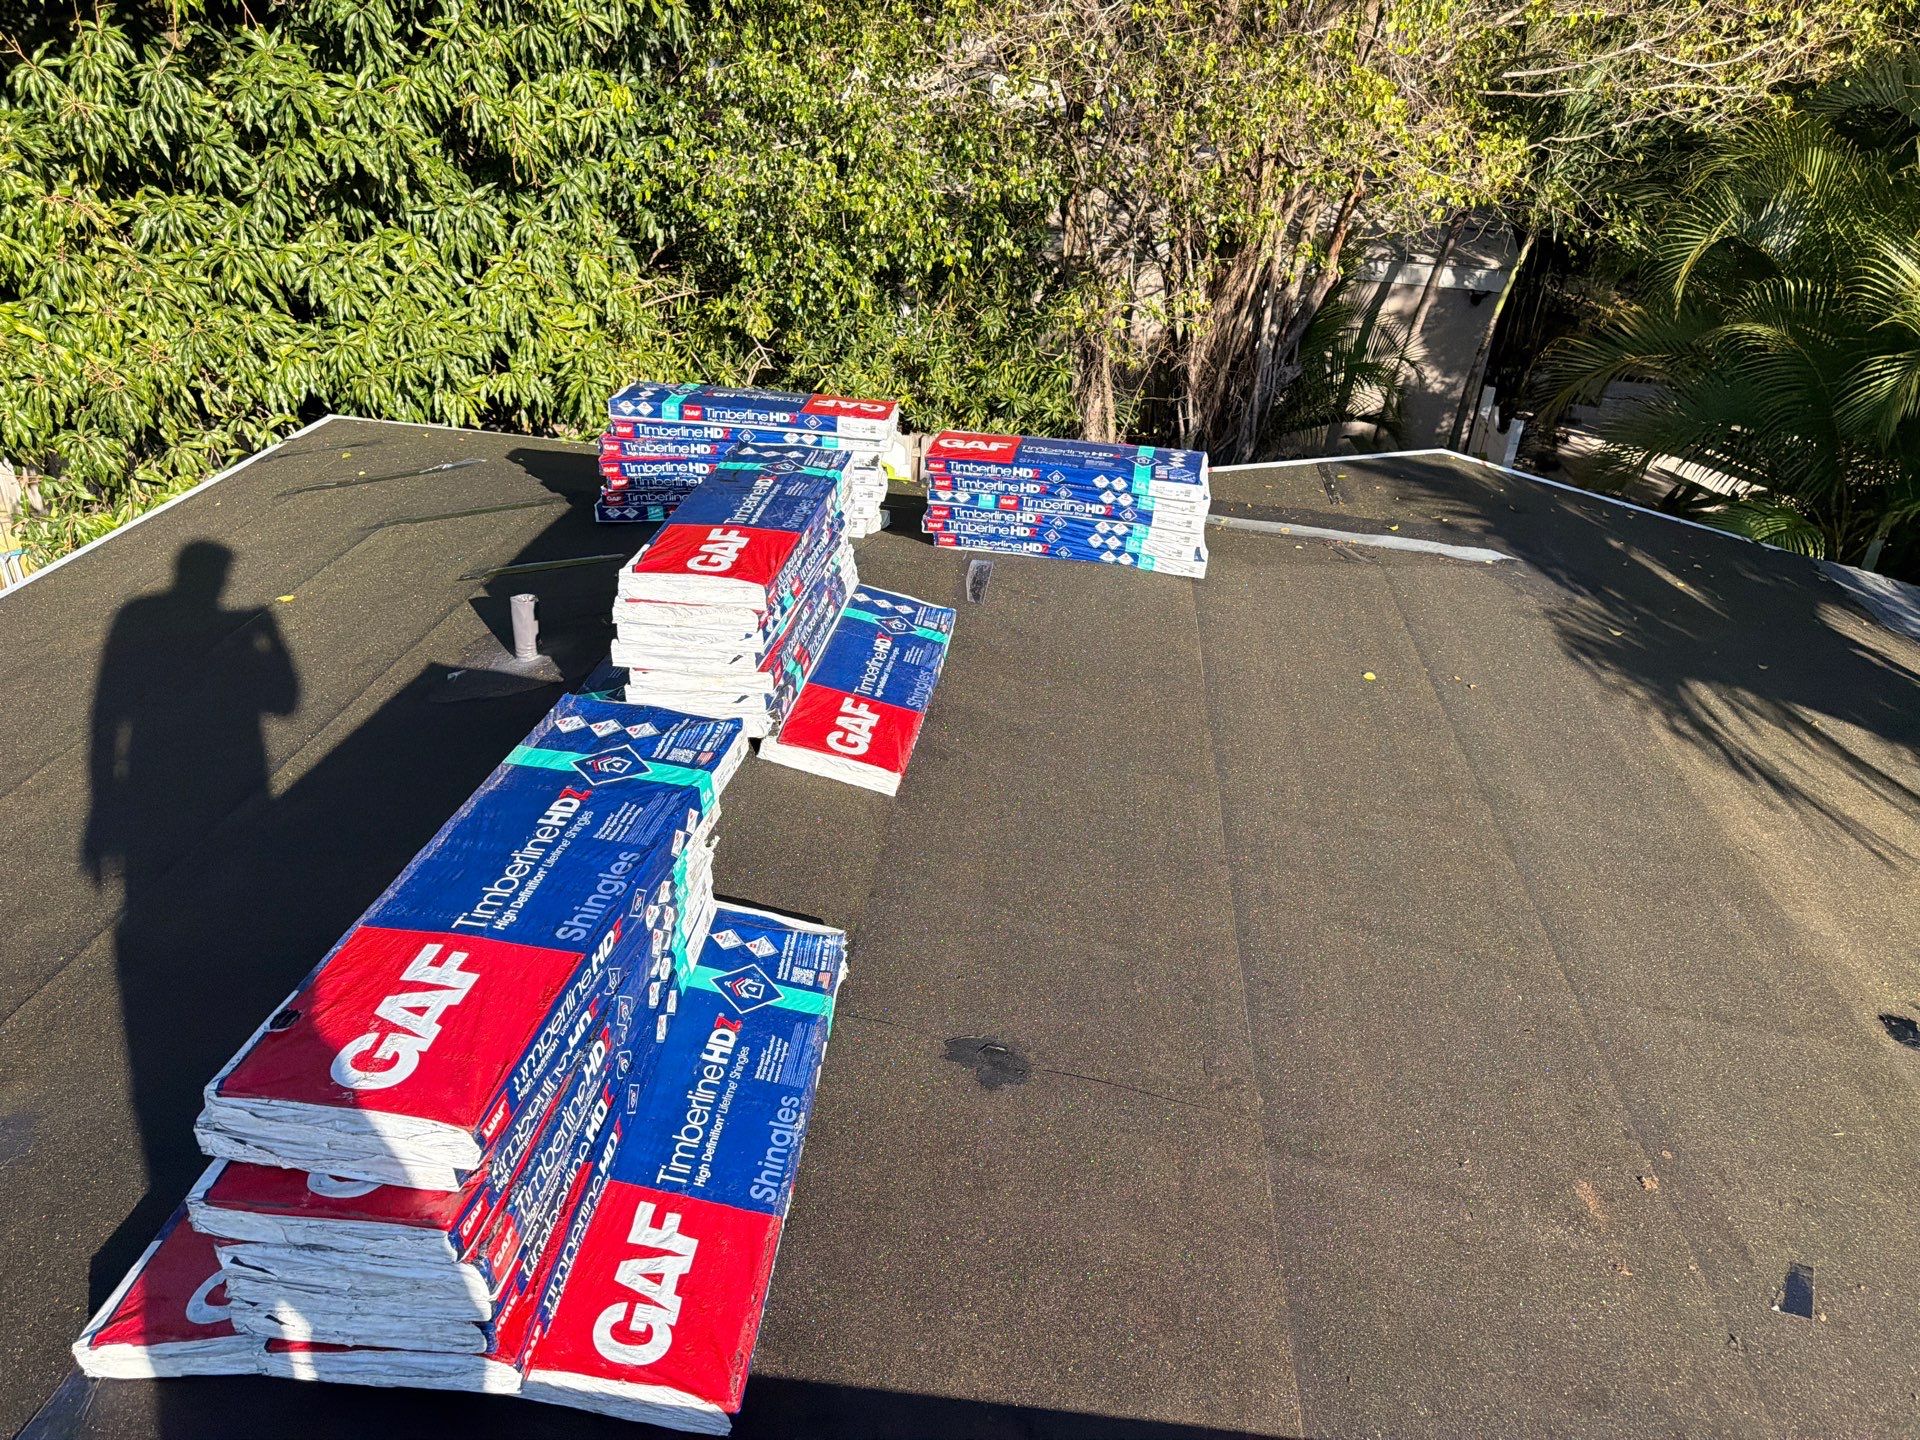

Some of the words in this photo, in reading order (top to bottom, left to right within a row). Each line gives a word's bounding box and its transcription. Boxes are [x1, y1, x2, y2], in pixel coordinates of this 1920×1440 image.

[684, 409, 700, 417] GAF
[813, 400, 887, 413] GAF
[938, 438, 1013, 451] GAF
[687, 528, 751, 572] GAF
[906, 668, 933, 708] Shingles
[826, 697, 880, 756] GAF
[493, 909, 517, 930] High
[570, 810, 594, 839] Shingles
[555, 851, 641, 941] Shingles
[330, 943, 481, 1090] GAF
[693, 1162, 711, 1188] High
[730, 1046, 750, 1079] Shingles
[750, 1095, 800, 1202] Shingles
[493, 1226, 514, 1269] GAF
[593, 1201, 699, 1366] GAF
